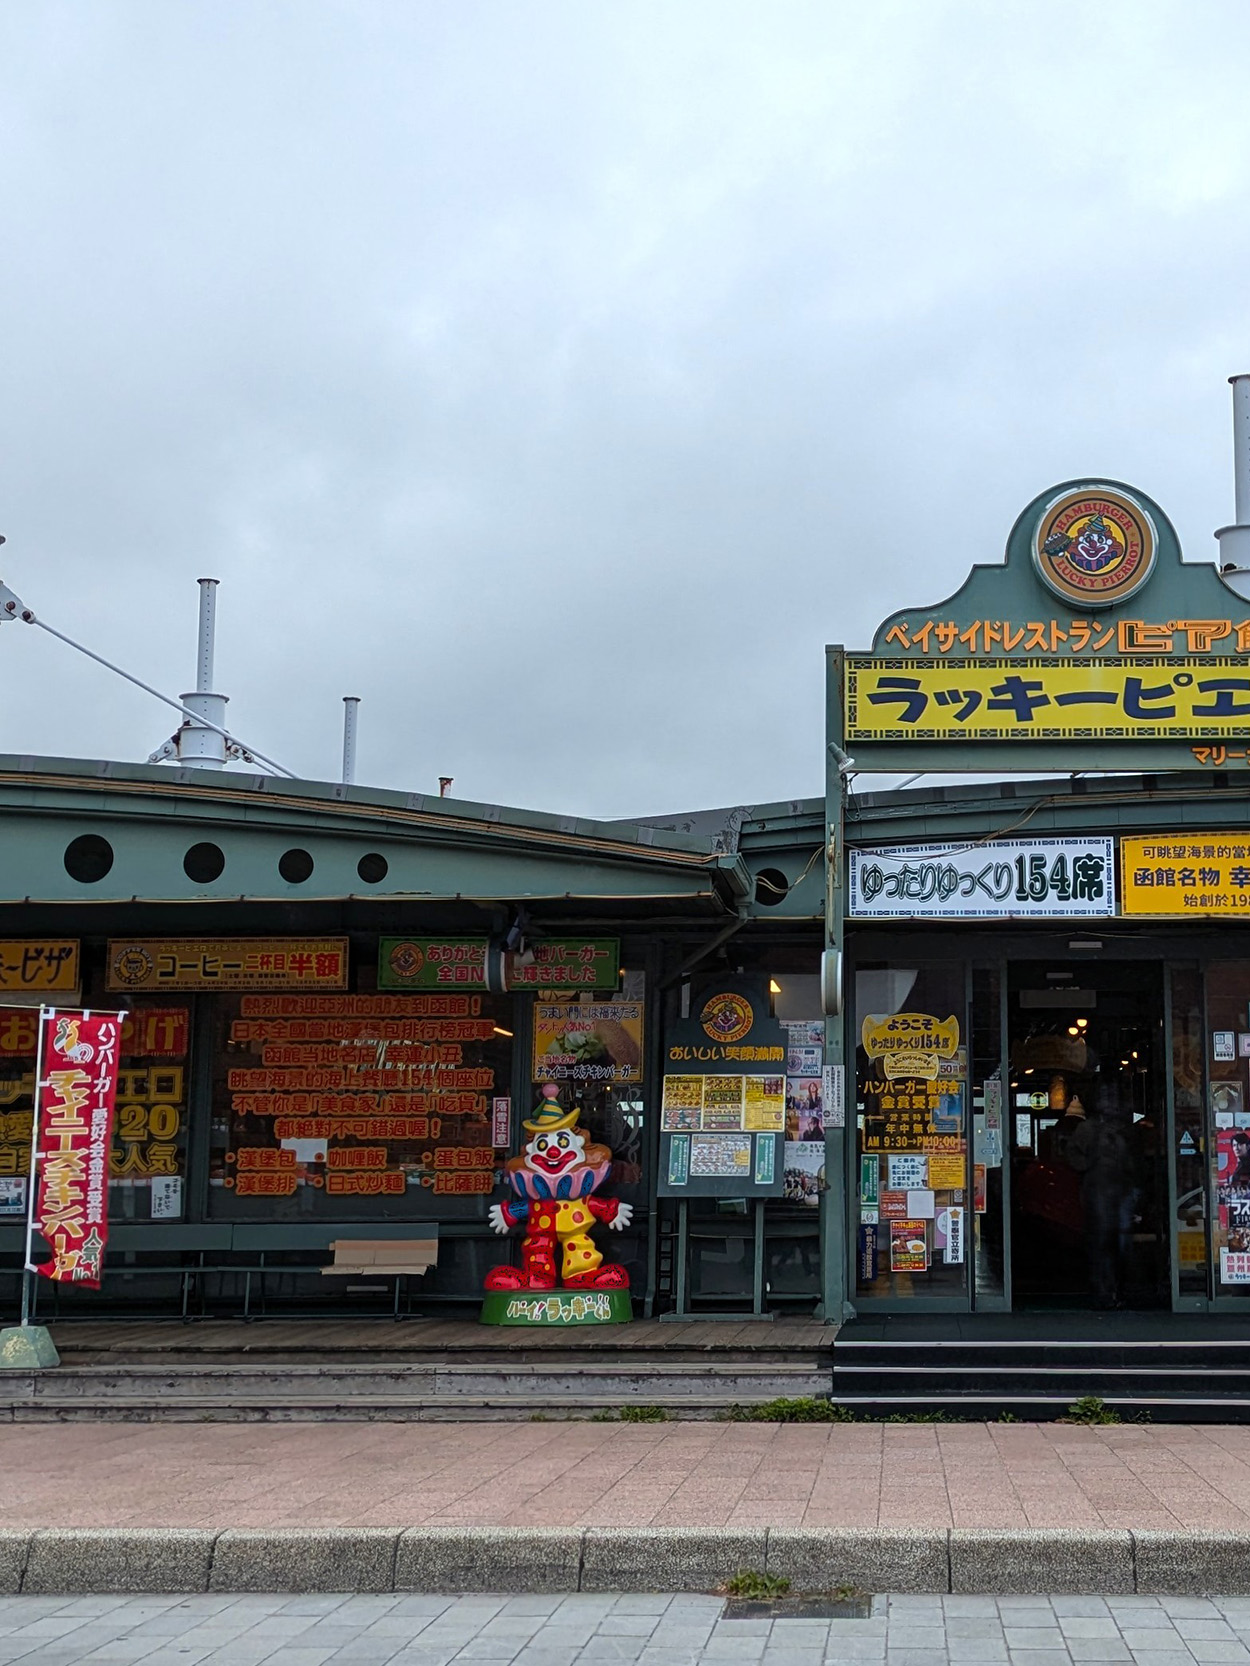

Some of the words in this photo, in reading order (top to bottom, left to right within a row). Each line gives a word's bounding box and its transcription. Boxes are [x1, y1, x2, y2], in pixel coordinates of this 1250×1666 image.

[1056, 502, 1133, 531] HAMBURGER
[1056, 559, 1097, 588] LUCKY
[1101, 541, 1140, 588] PIERROT
[861, 851, 1106, 904] ゆったりゆっくり154席
[1133, 866, 1220, 888] 函館名物
[706, 994, 749, 1012] HAMBURGER
[706, 1026, 728, 1041] LUCKY
[730, 1015, 752, 1041] PIERROT
[887, 1018, 934, 1031] ようこそ
[386, 1046, 462, 1065] 幸運小丑
[537, 1064, 638, 1078] チャイニーズチキンバーガー
[495, 1101, 508, 1146] 落雪注意
[238, 1149, 296, 1169] 漢堡包
[436, 1149, 494, 1169] 蛋包飯
[237, 1174, 296, 1194] 漢堡排
